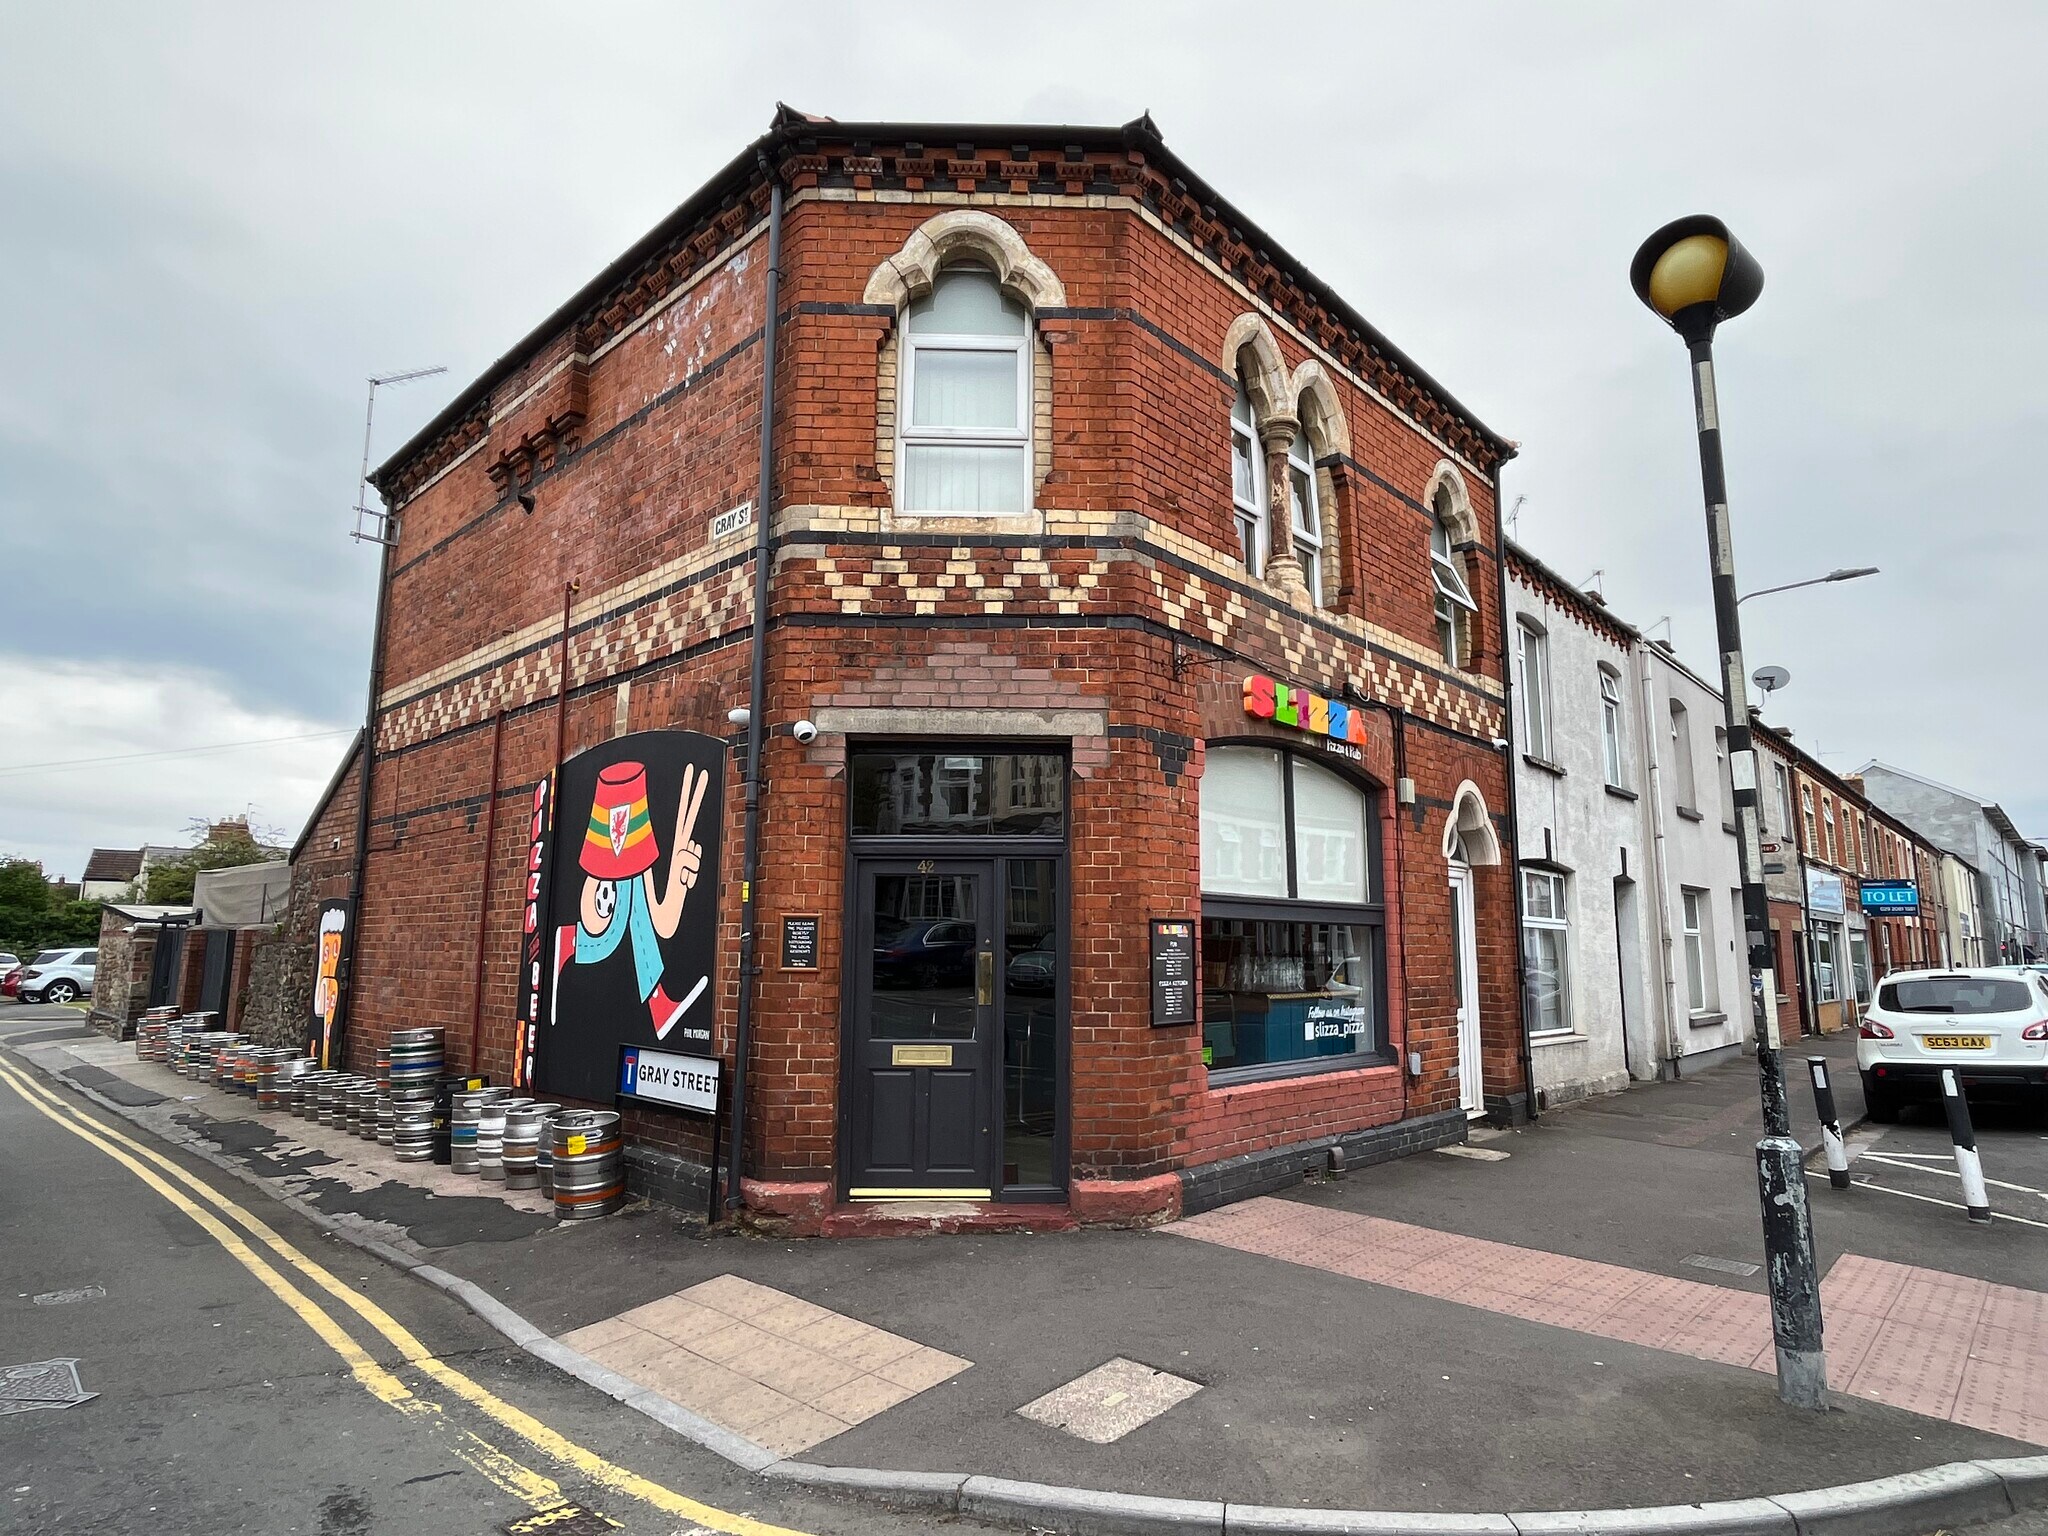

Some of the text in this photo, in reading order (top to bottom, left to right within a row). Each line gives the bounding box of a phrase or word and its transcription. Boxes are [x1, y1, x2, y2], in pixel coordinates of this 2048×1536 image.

[1243, 674, 1368, 746] SLIZZA
[1326, 739, 1345, 754] Pizza
[1349, 745, 1362, 760] Pub
[525, 779, 547, 933] PIZZA
[917, 860, 935, 873] 42
[1863, 891, 1914, 902] TO LET
[525, 961, 540, 1088] BEER
[1315, 1021, 1365, 1039] slizza_pizza
[1928, 1037, 1986, 1047] SC63 GAX
[639, 1064, 719, 1094] GRAY STREET
